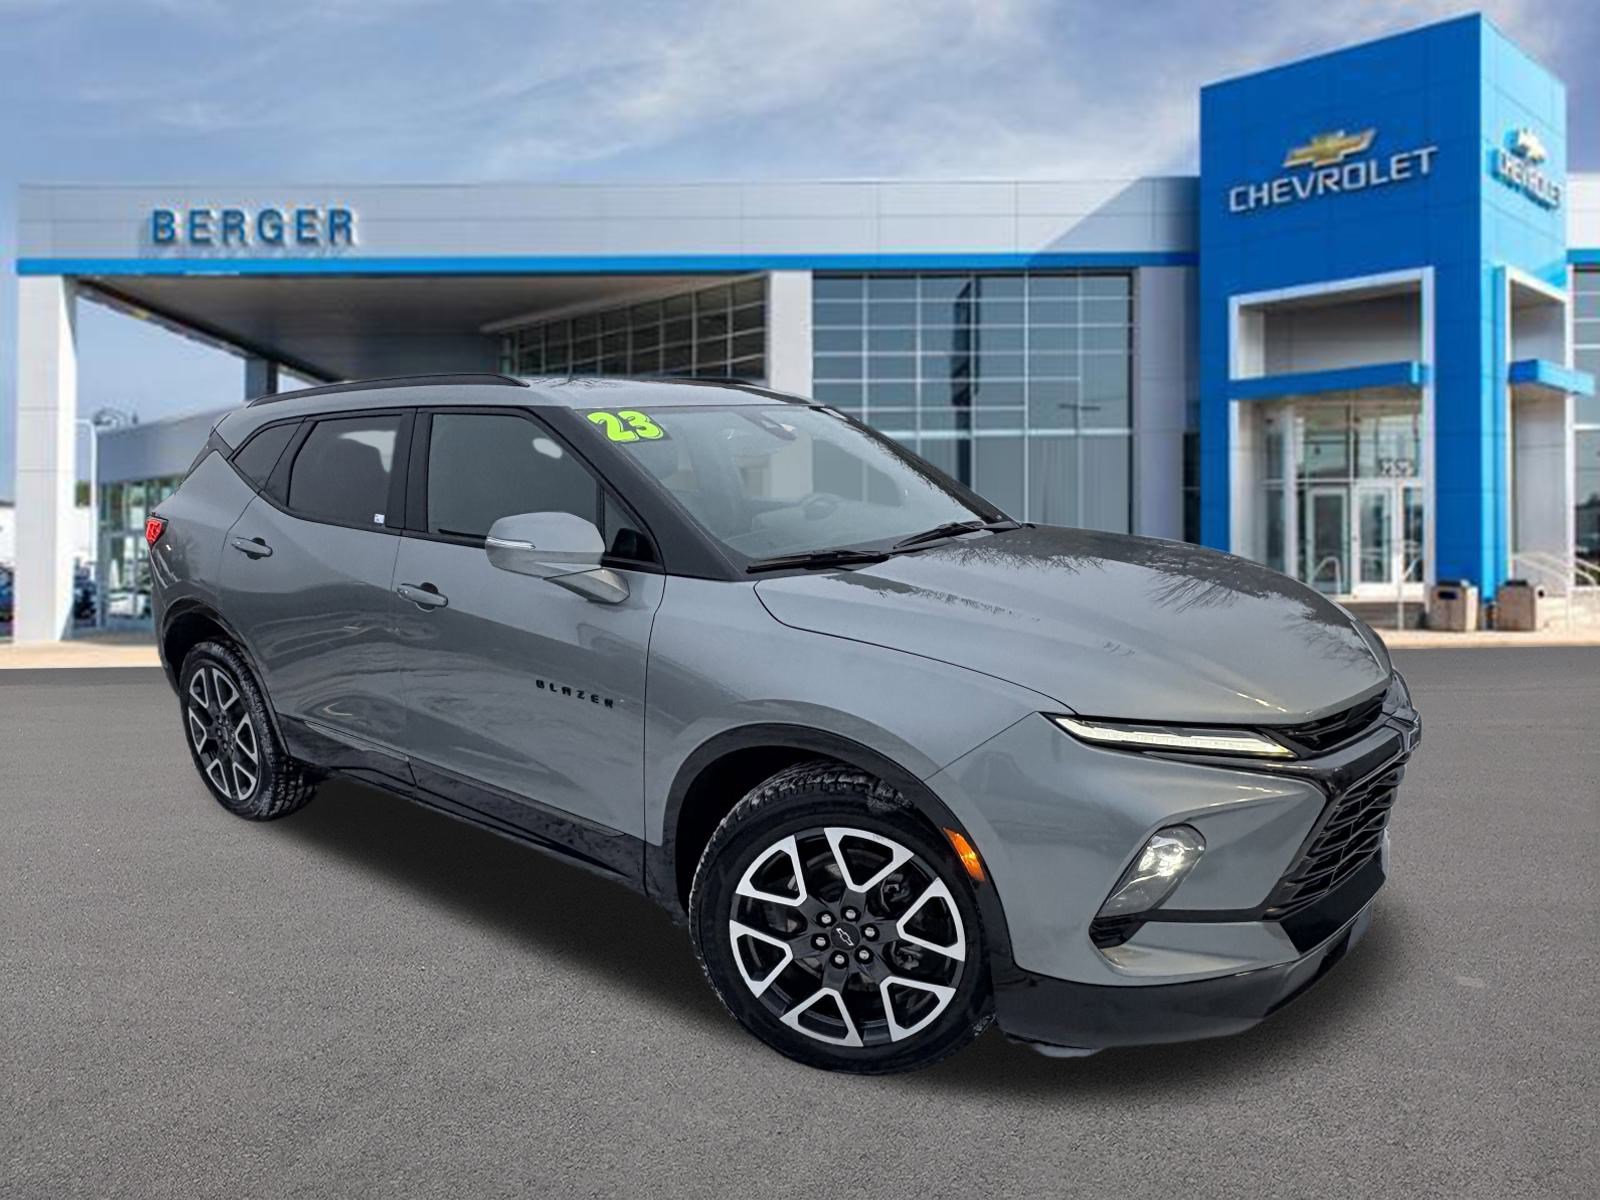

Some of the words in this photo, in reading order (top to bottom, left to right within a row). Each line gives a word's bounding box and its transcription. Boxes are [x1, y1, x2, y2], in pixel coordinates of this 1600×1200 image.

[1229, 146, 1438, 213] CHEVROLET
[152, 208, 356, 246] BERGER
[586, 410, 664, 442] 23
[535, 679, 614, 709] BLAZER
